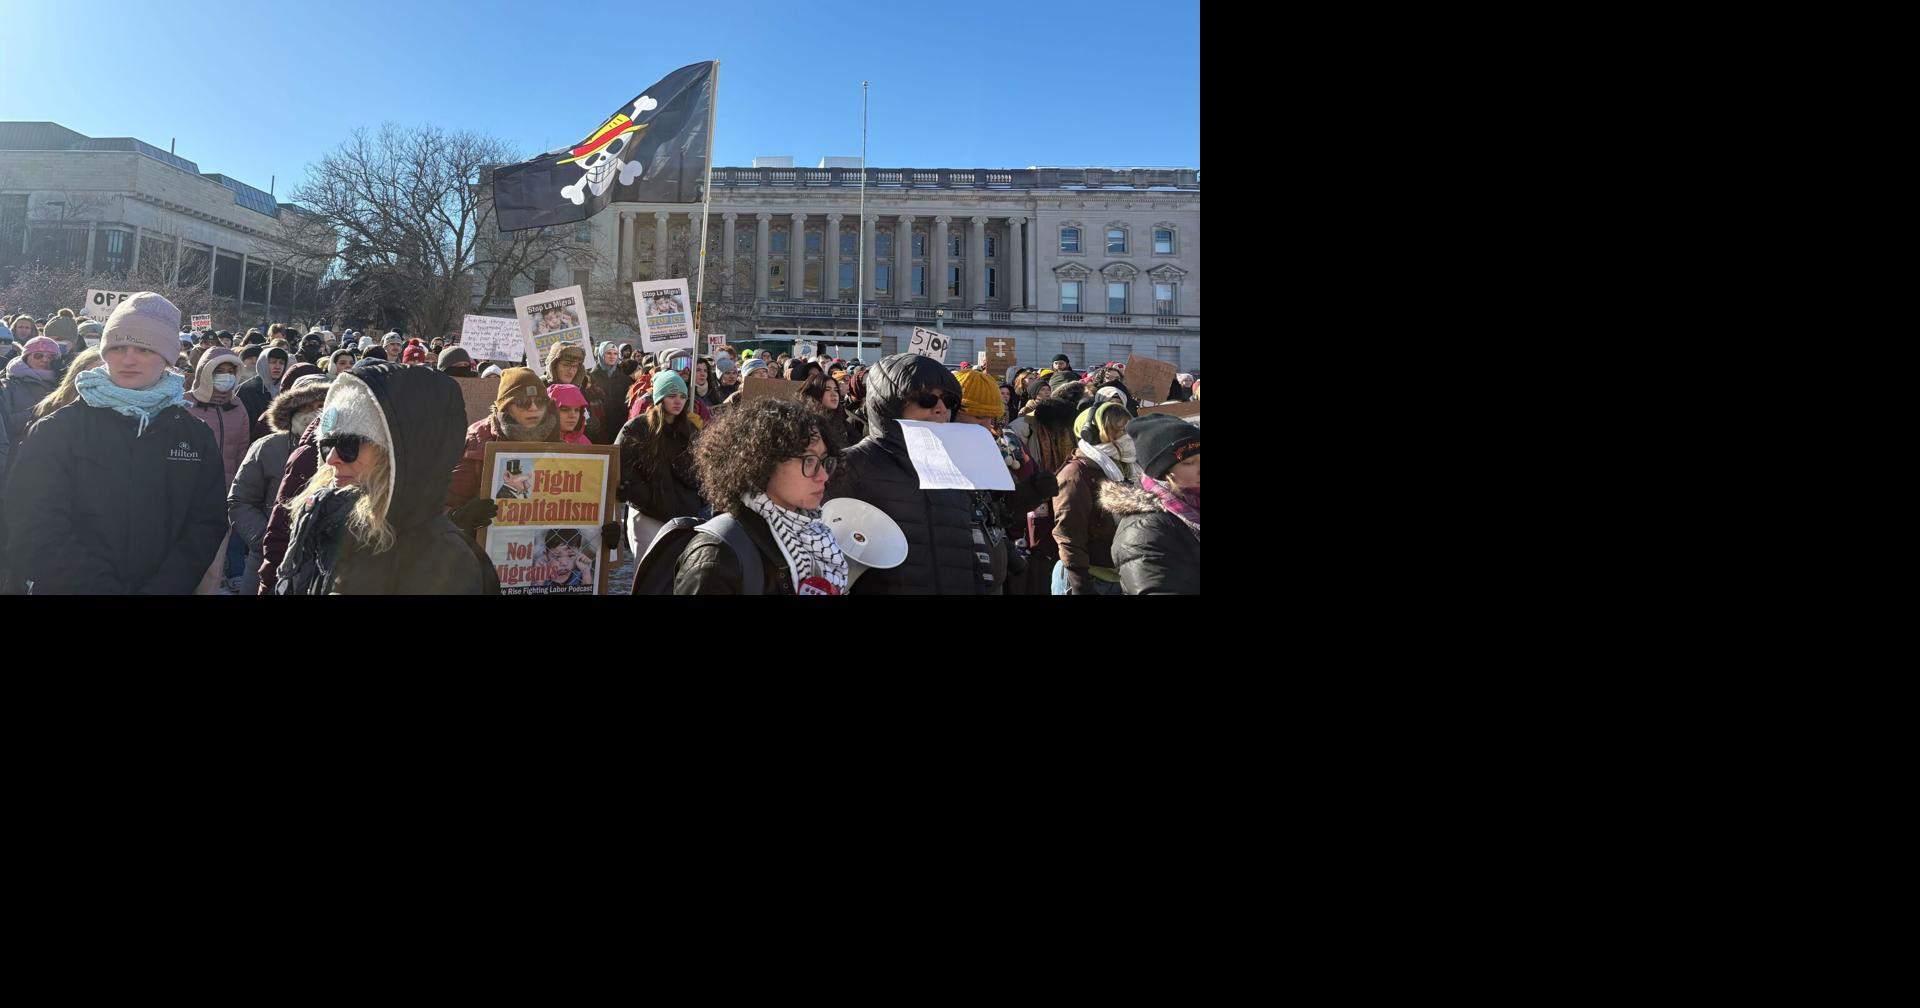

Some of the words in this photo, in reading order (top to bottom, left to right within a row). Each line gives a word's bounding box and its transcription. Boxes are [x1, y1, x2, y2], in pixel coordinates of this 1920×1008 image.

[93, 292, 128, 306] OPE
[527, 304, 544, 314] Stop
[543, 302, 552, 310] La
[552, 297, 576, 308] Migra!
[709, 335, 723, 345] MELT
[911, 329, 948, 358] STOP
[170, 449, 198, 458] Hilton
[532, 470, 583, 495] Fight
[496, 499, 599, 525] Capitalism
[507, 542, 533, 561] Not
[508, 587, 522, 596] Rise
[523, 586, 549, 596] Fighting
[568, 585, 593, 593] Podcast
